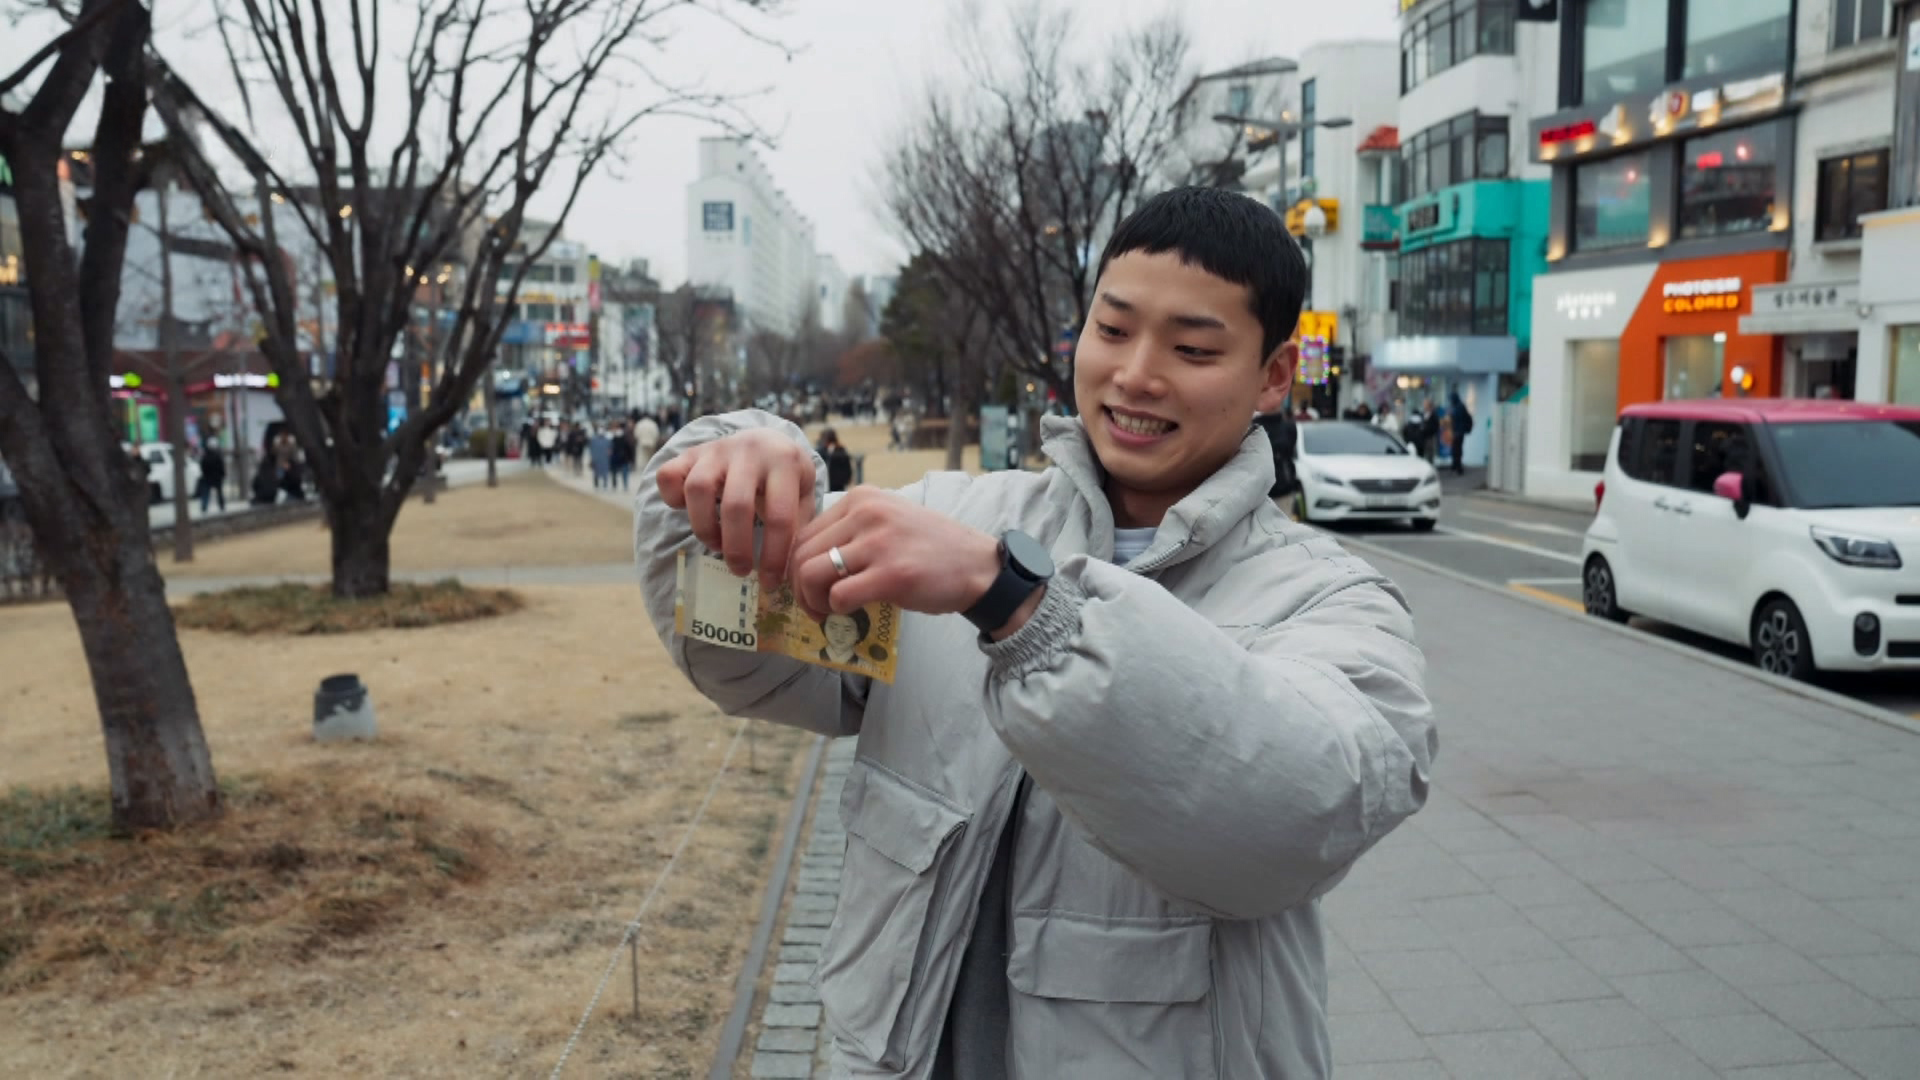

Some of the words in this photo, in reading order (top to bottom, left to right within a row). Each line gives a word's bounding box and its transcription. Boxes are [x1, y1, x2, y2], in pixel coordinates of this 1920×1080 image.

[1663, 277, 1742, 297] PHOTOISM
[1663, 294, 1739, 313] COLORED
[691, 619, 756, 647] 50000
